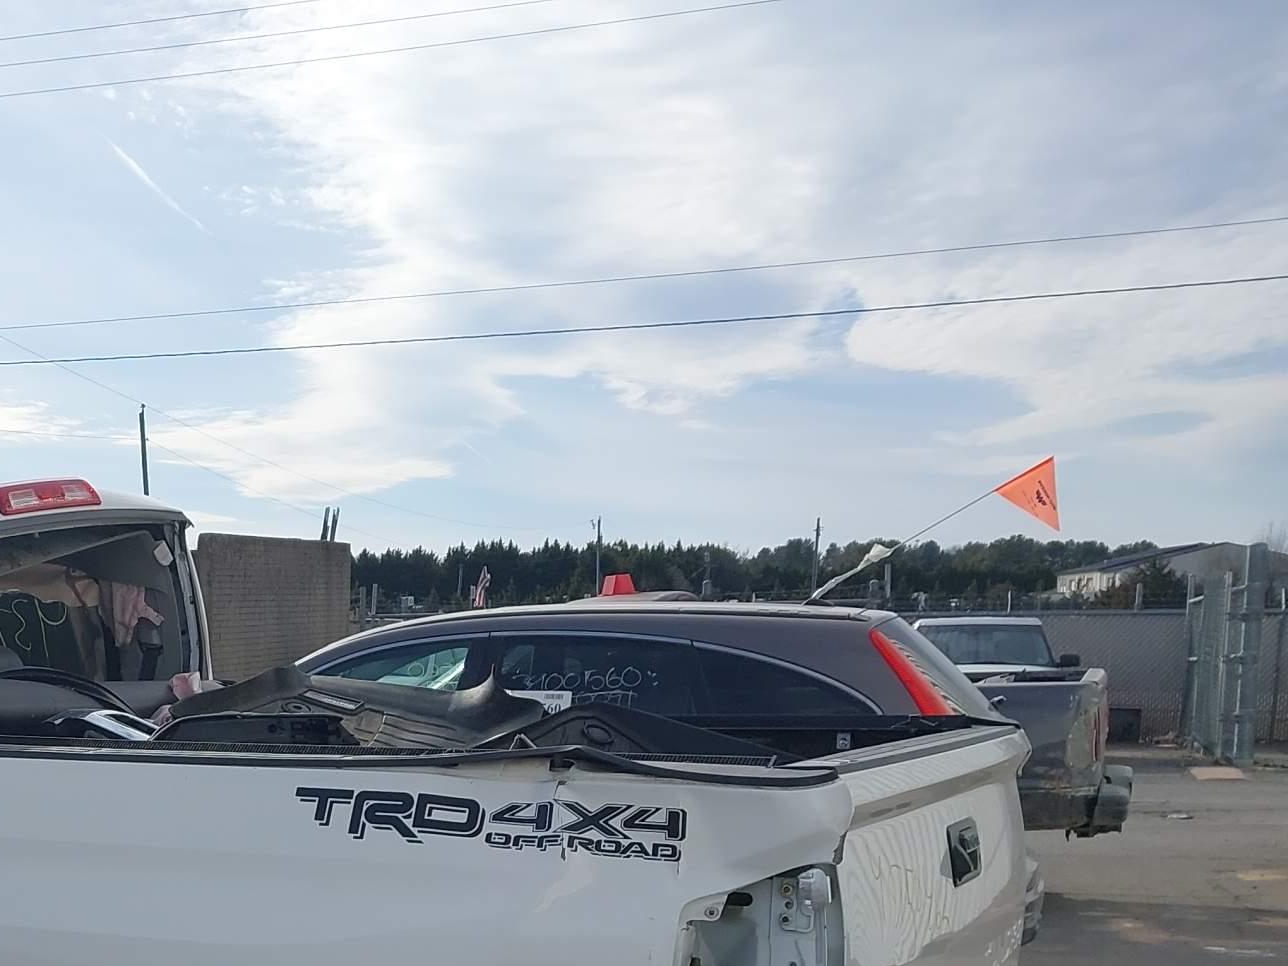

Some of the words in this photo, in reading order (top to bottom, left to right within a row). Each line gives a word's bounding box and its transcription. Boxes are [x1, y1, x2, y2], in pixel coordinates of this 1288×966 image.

[295, 787, 486, 844] TRD
[485, 832, 564, 851] OFF
[567, 835, 682, 862] ROAD
